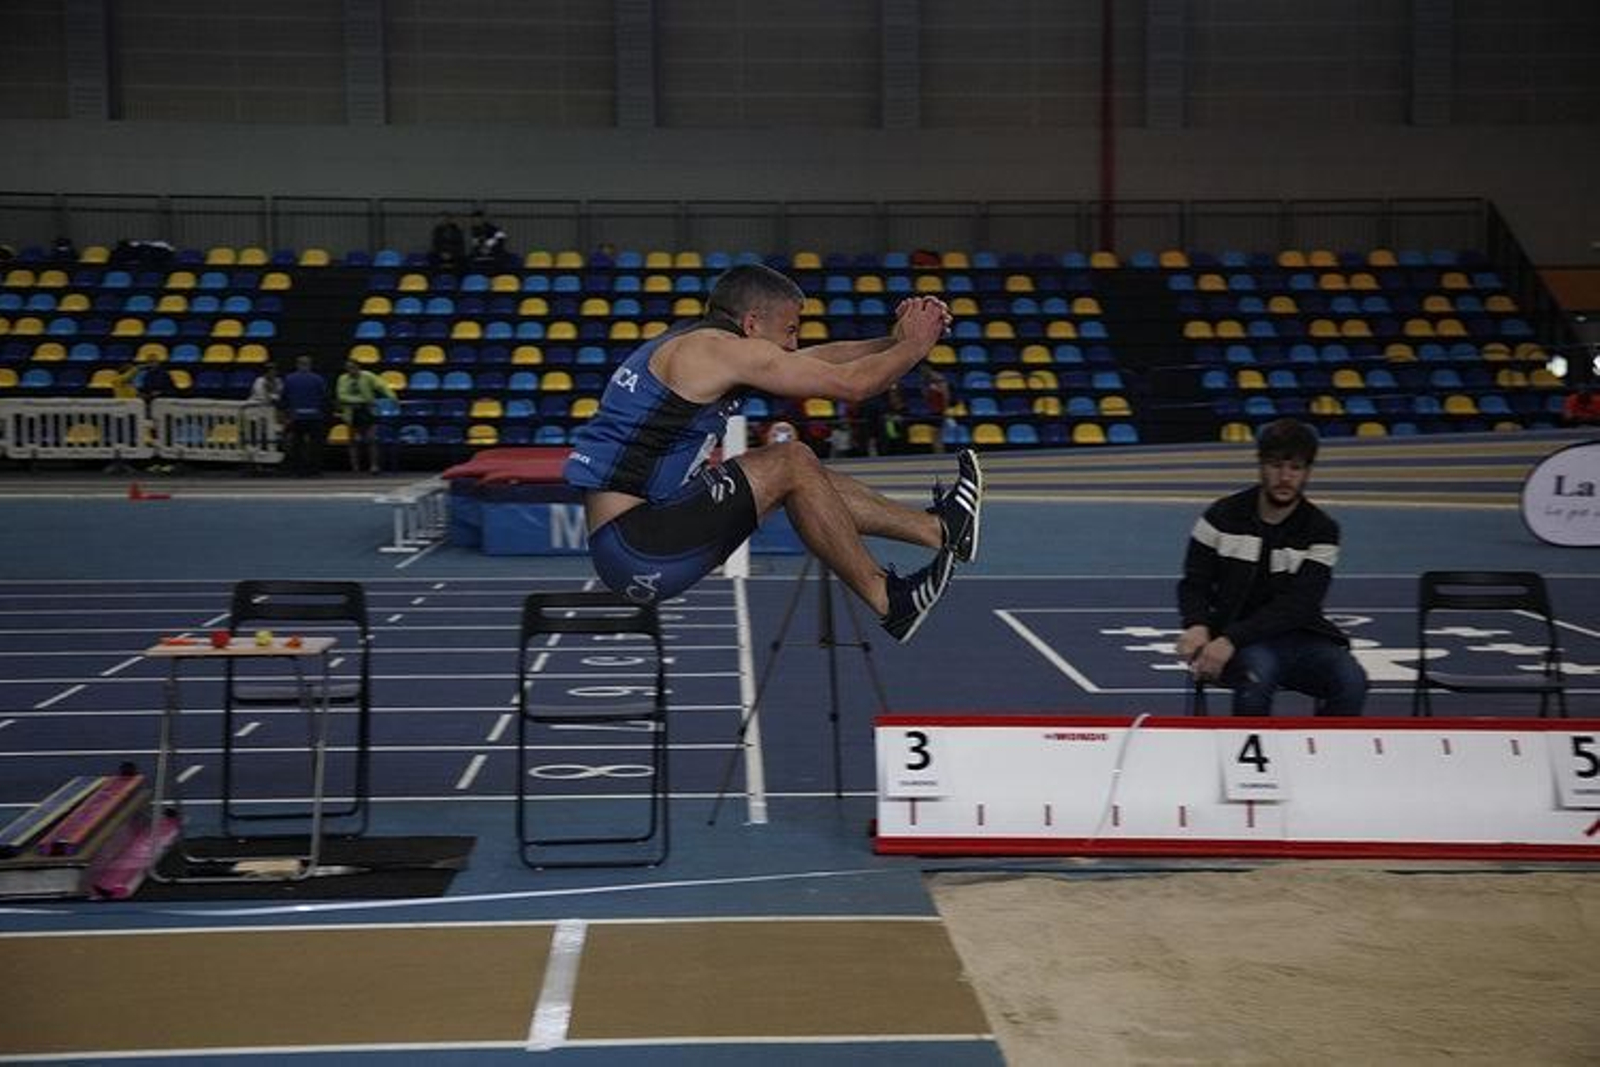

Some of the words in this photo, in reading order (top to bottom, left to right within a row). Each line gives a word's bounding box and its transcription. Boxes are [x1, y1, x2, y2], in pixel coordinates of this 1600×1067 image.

[1552, 475, 1596, 497] La
[904, 730, 930, 770] 3
[1237, 733, 1269, 773] 4
[1571, 735, 1599, 778] 5
